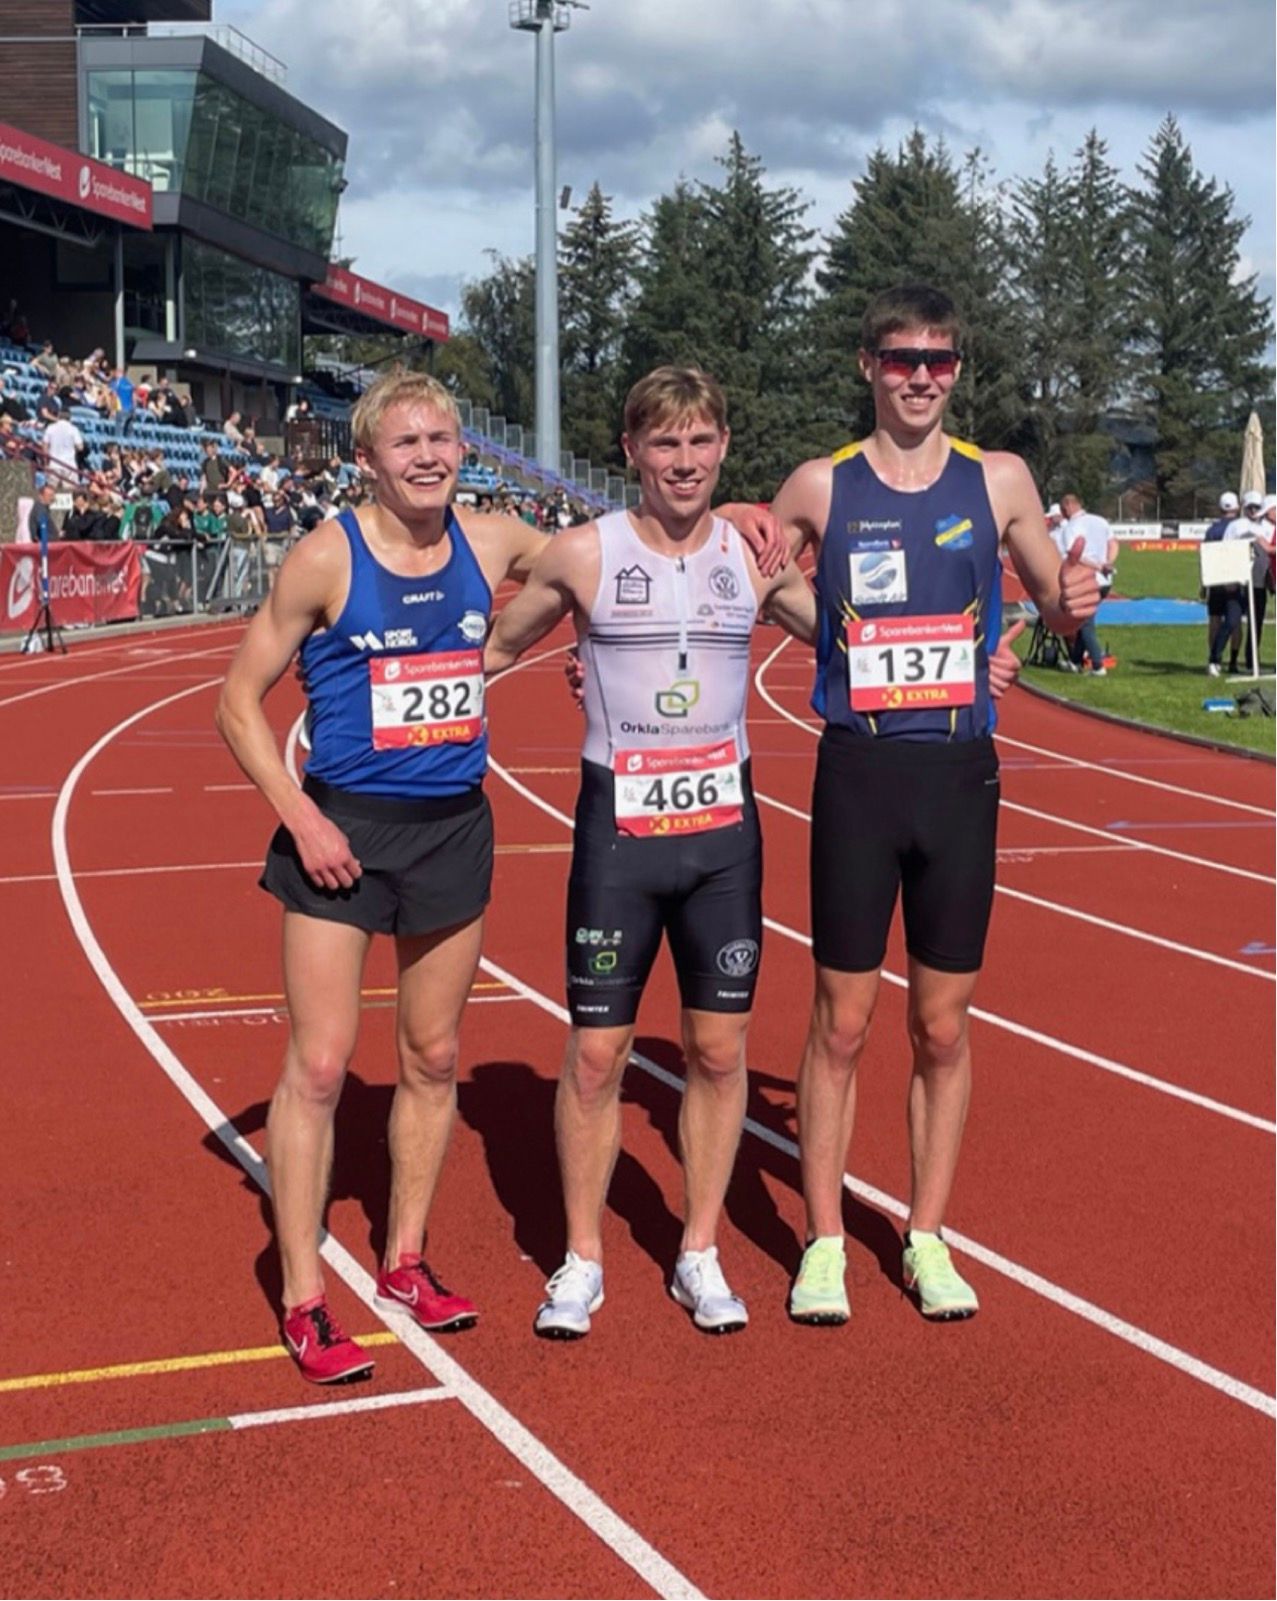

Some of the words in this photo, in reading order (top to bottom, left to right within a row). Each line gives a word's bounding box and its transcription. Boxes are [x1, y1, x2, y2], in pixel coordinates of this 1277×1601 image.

[878, 646, 951, 683] 137
[402, 681, 471, 722] 282
[906, 687, 949, 701] EXTRA
[431, 725, 471, 739] EXTRA
[642, 773, 719, 811] 466
[673, 813, 713, 829] EXTRA
